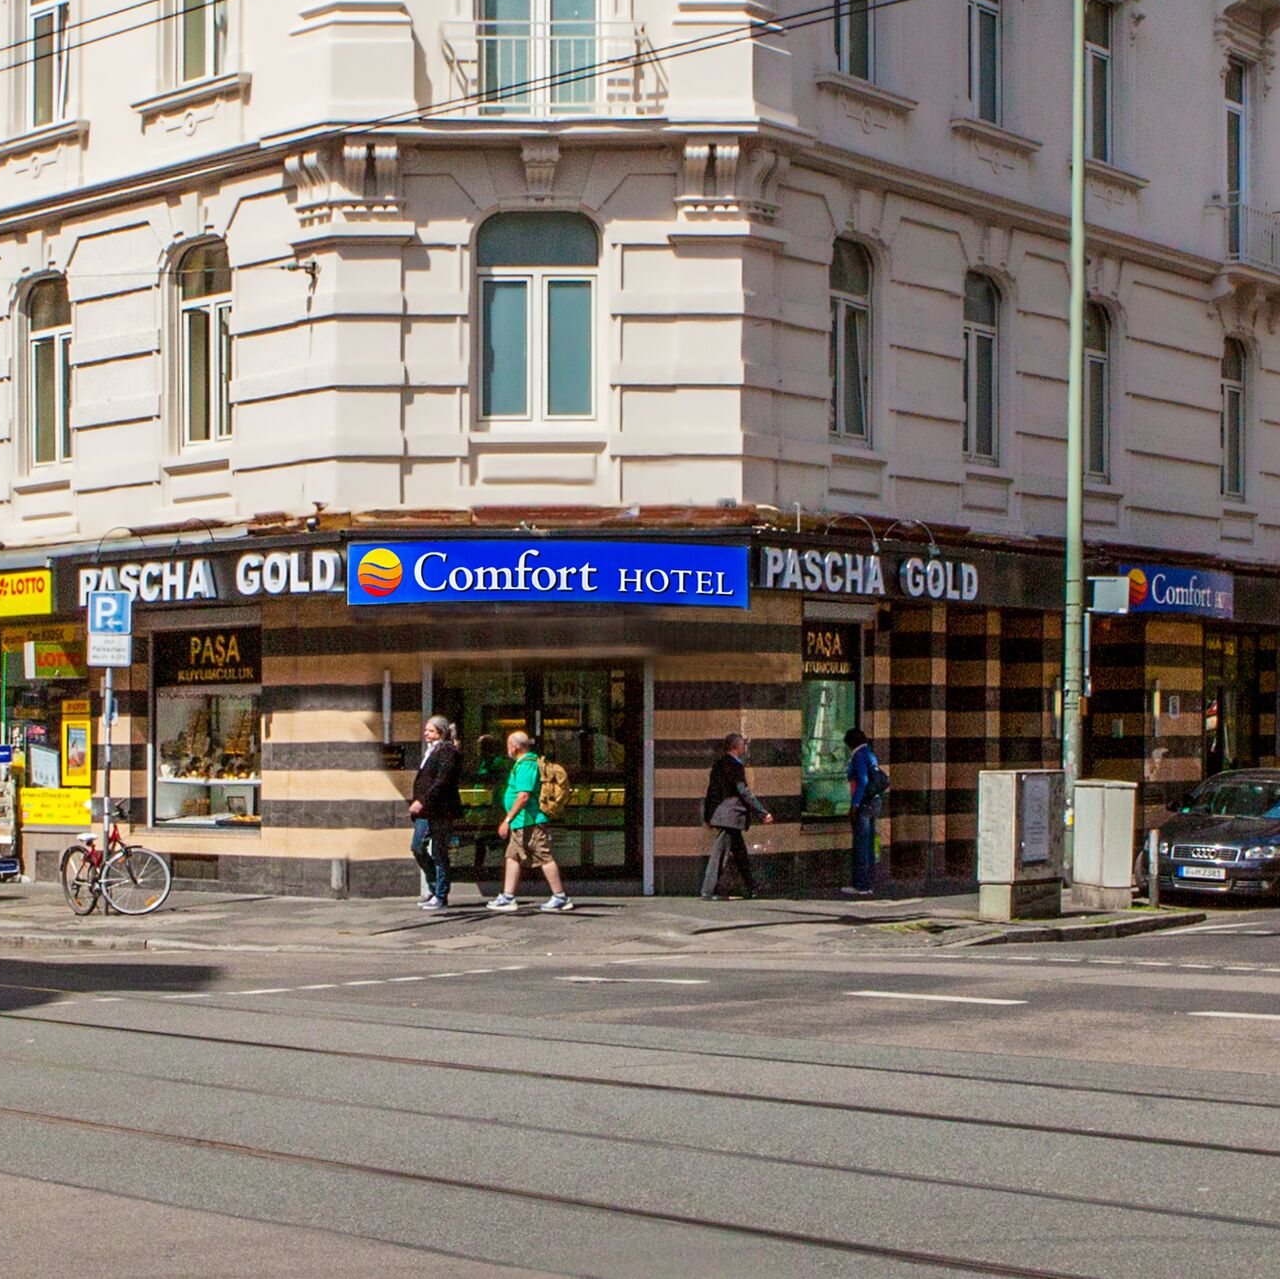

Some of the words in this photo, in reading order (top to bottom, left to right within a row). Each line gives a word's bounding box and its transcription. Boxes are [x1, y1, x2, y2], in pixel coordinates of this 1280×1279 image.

[10, 577, 45, 595] LOTTO
[79, 559, 217, 607] PASCHA
[236, 549, 345, 595] GOLD
[414, 548, 598, 592] Comfort
[618, 568, 734, 595] HOTEL
[761, 547, 885, 595] PASCHA
[900, 557, 979, 600] GOLD
[1151, 573, 1211, 608] Comfort
[37, 651, 82, 667] LOTTO
[190, 634, 240, 666] PAŞA
[807, 631, 843, 656] PAŞA
